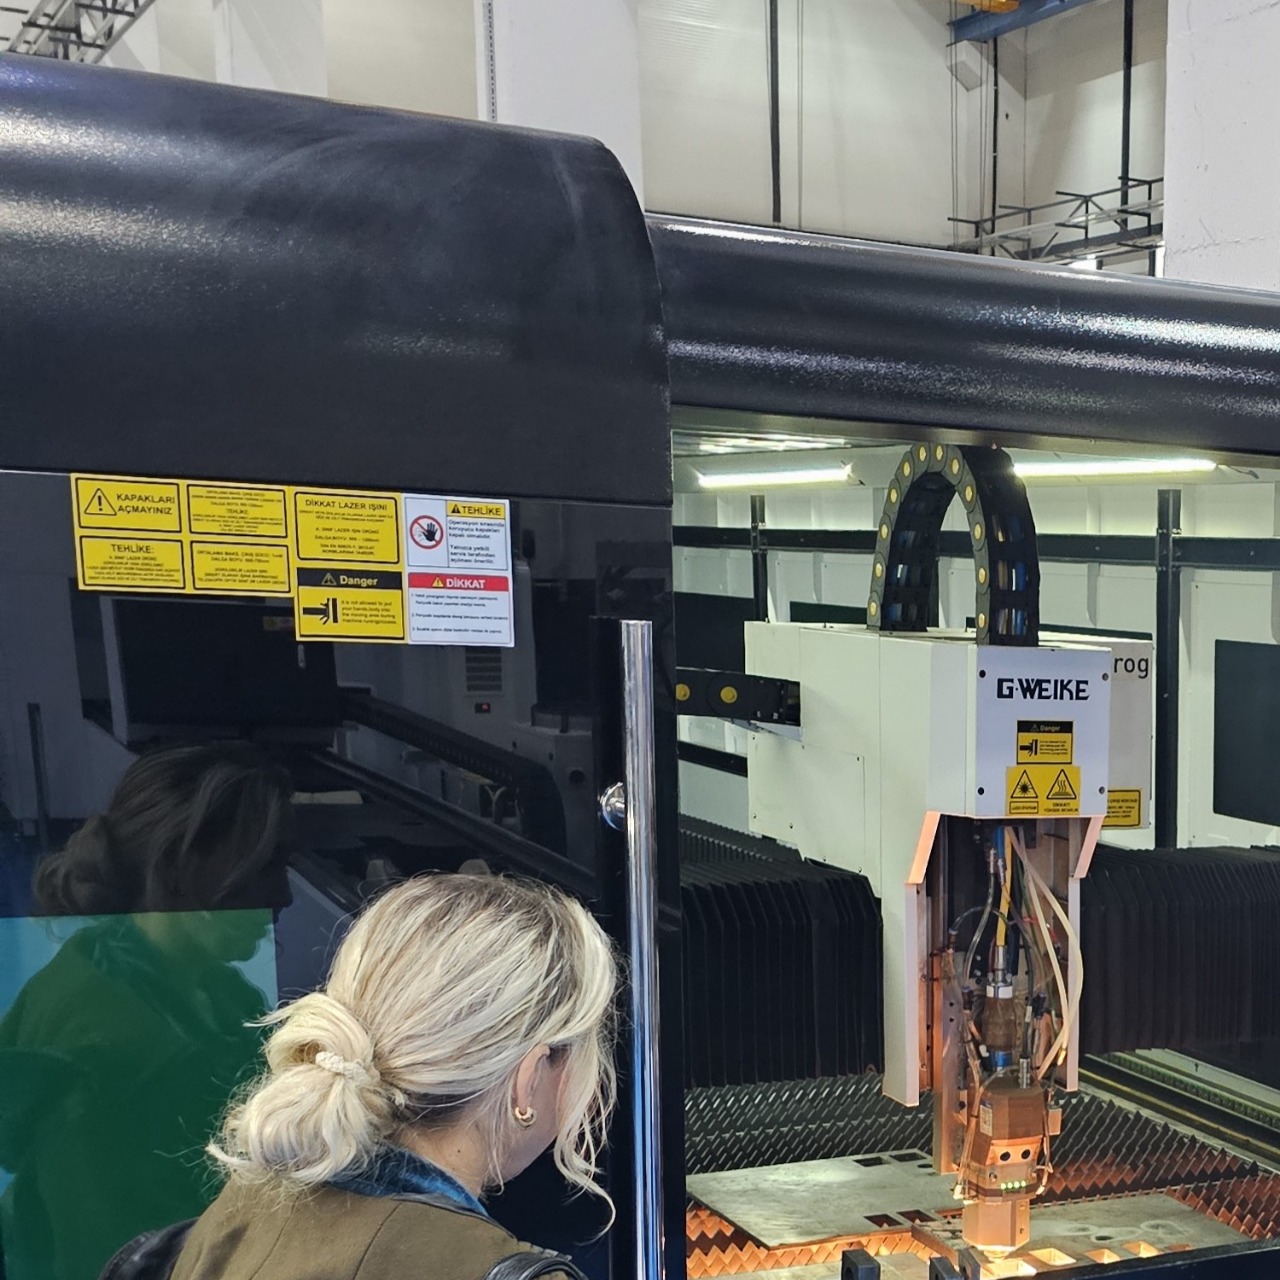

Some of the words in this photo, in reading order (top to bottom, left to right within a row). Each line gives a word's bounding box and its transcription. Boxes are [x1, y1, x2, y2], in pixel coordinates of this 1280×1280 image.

[117, 493, 175, 504] KAPAKLARI
[306, 499, 336, 508] DİKKAT
[118, 505, 173, 515] AÇMAYINIZ
[462, 505, 501, 516] TEHLİKE
[340, 575, 378, 587] Danger
[446, 577, 486, 589] DİKKAT
